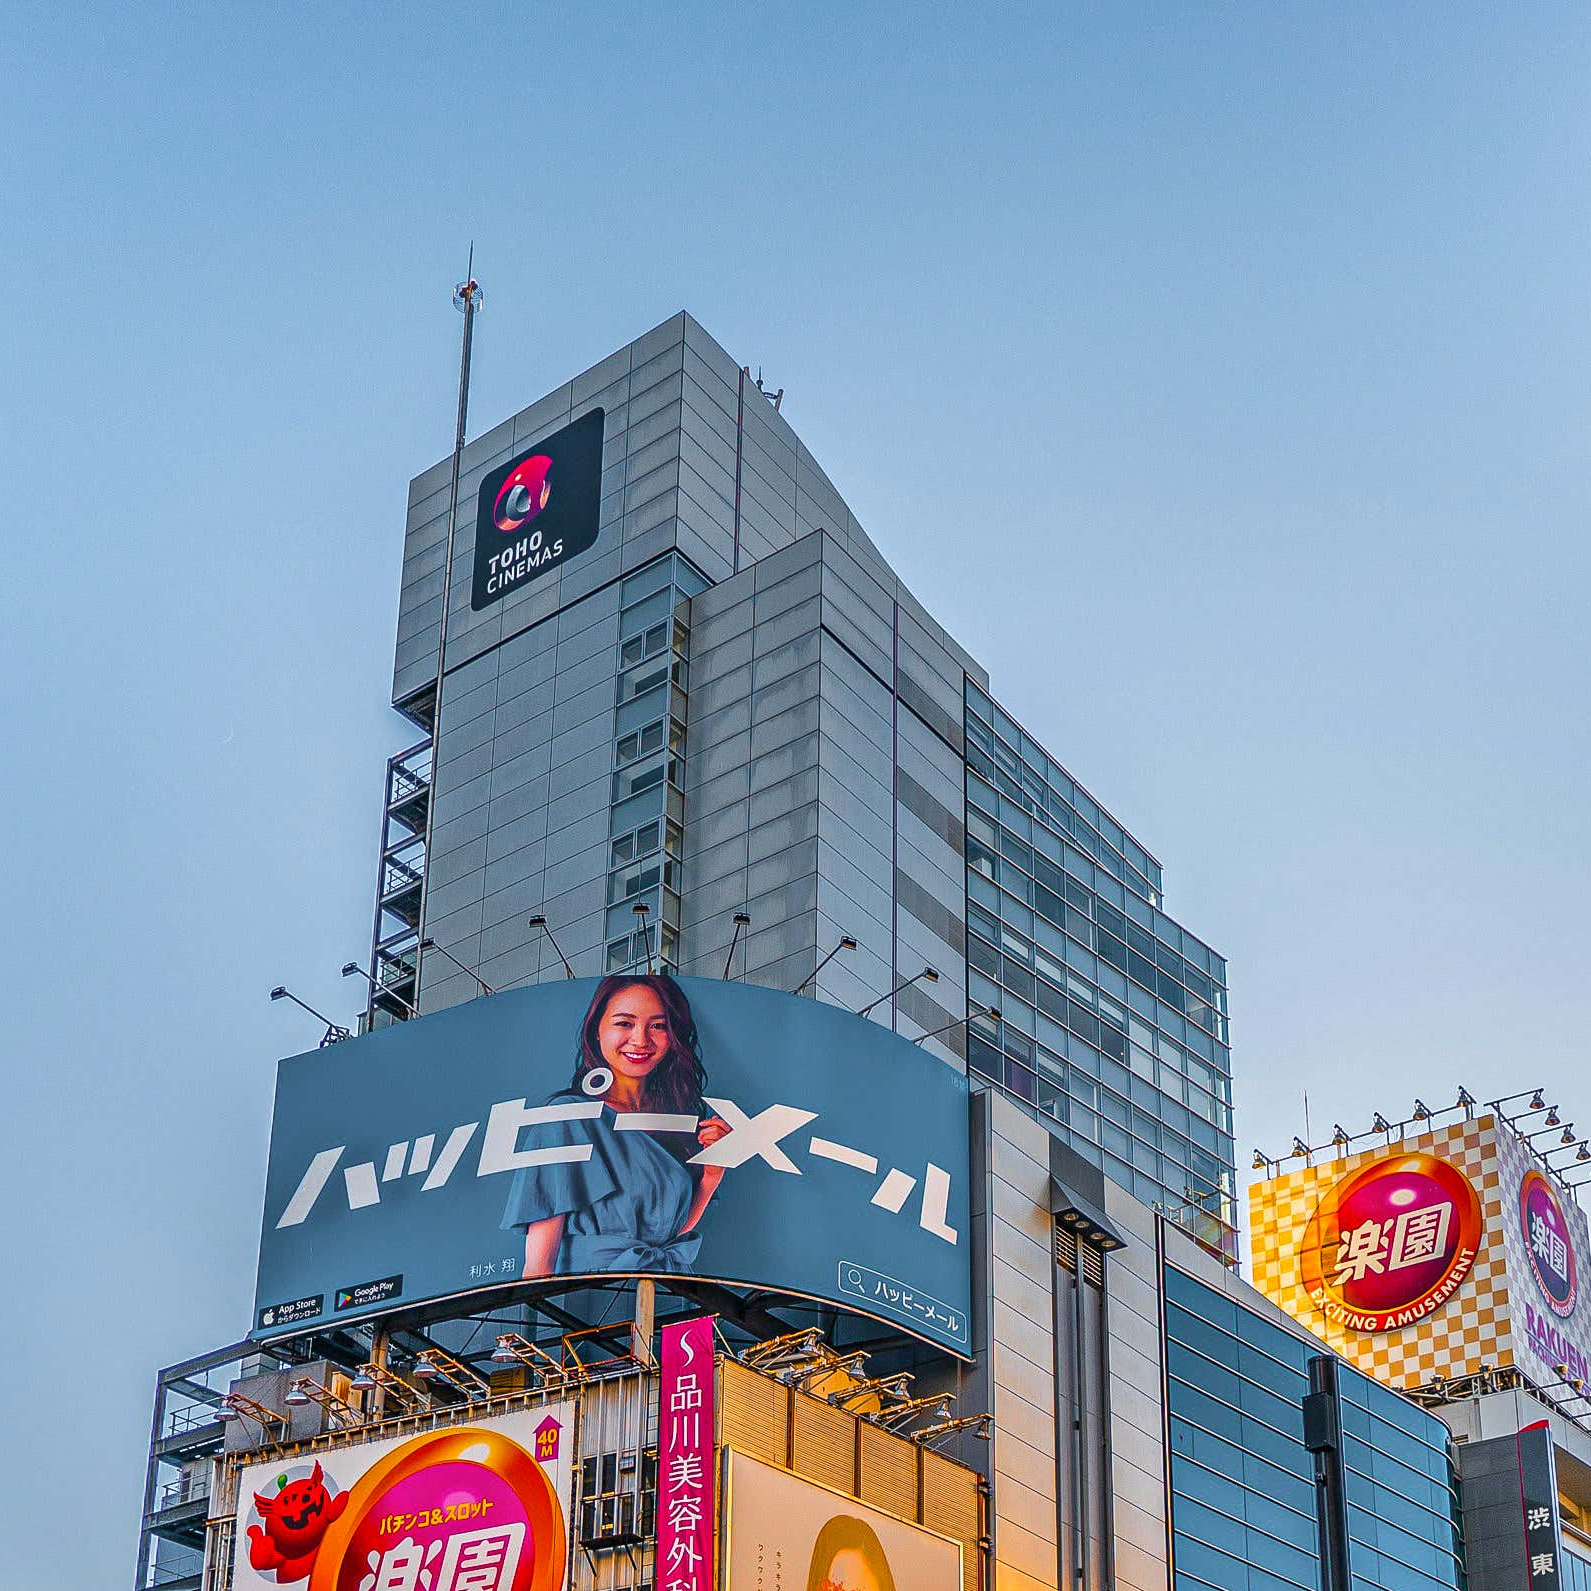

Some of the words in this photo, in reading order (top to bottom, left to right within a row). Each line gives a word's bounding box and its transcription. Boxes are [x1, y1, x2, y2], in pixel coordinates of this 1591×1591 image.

[487, 539, 563, 594] CINEMAS
[489, 531, 543, 575] TOHO
[275, 1067, 958, 1246] ハッピーメール
[1332, 1201, 1452, 1287] 楽園
[1532, 1211, 1568, 1282] 楽園
[279, 1304, 295, 1315] App
[296, 1298, 316, 1310] Store
[354, 1284, 379, 1297] Google
[380, 1281, 394, 1291] Play
[875, 1280, 959, 1332] ハッピーメール
[1310, 1286, 1378, 1331] EXCITING
[1384, 1247, 1474, 1330] AMUSEMENT
[277, 1307, 321, 1324] からダウンロード
[1525, 1302, 1588, 1382] RAKUEN
[537, 1430, 557, 1446] 40
[540, 1445, 554, 1458] M
